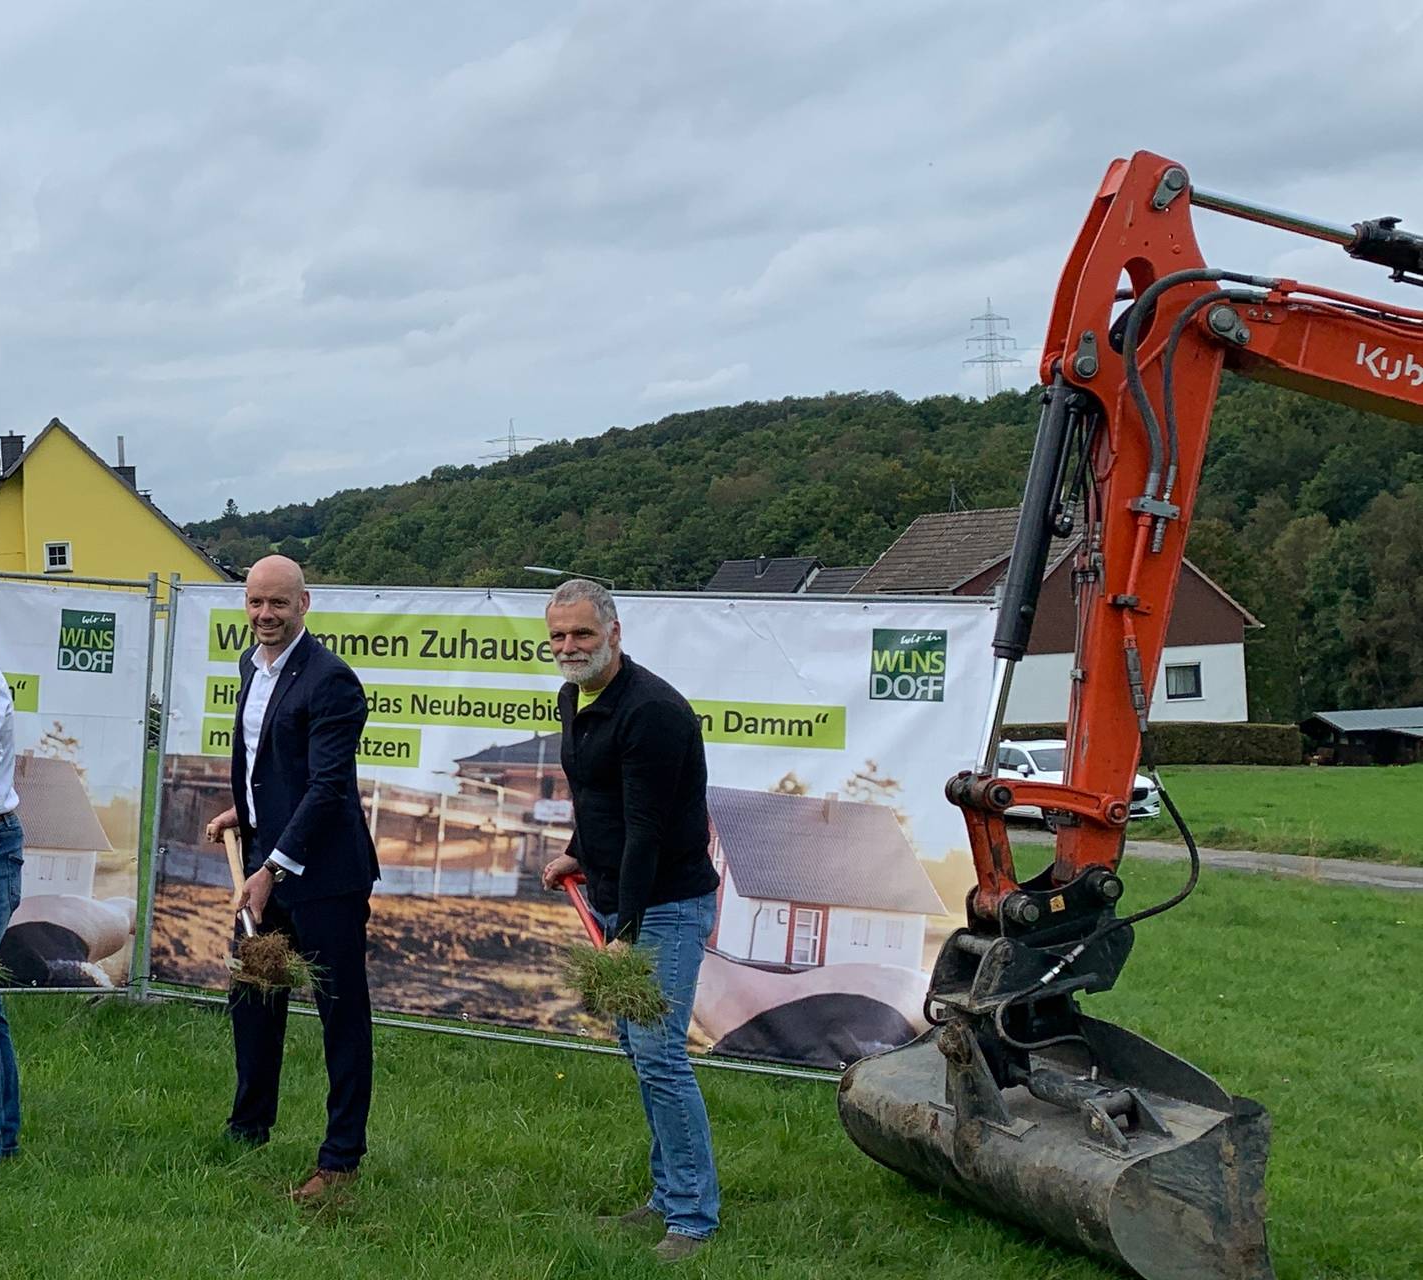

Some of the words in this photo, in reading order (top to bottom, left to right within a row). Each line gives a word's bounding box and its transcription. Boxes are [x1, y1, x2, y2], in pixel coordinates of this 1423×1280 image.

[1356, 342, 1423, 386] Kub
[419, 628, 554, 663] Zuhause
[365, 690, 403, 714] das
[410, 693, 562, 725] Neubaugebie
[724, 710, 829, 737] Damm“
